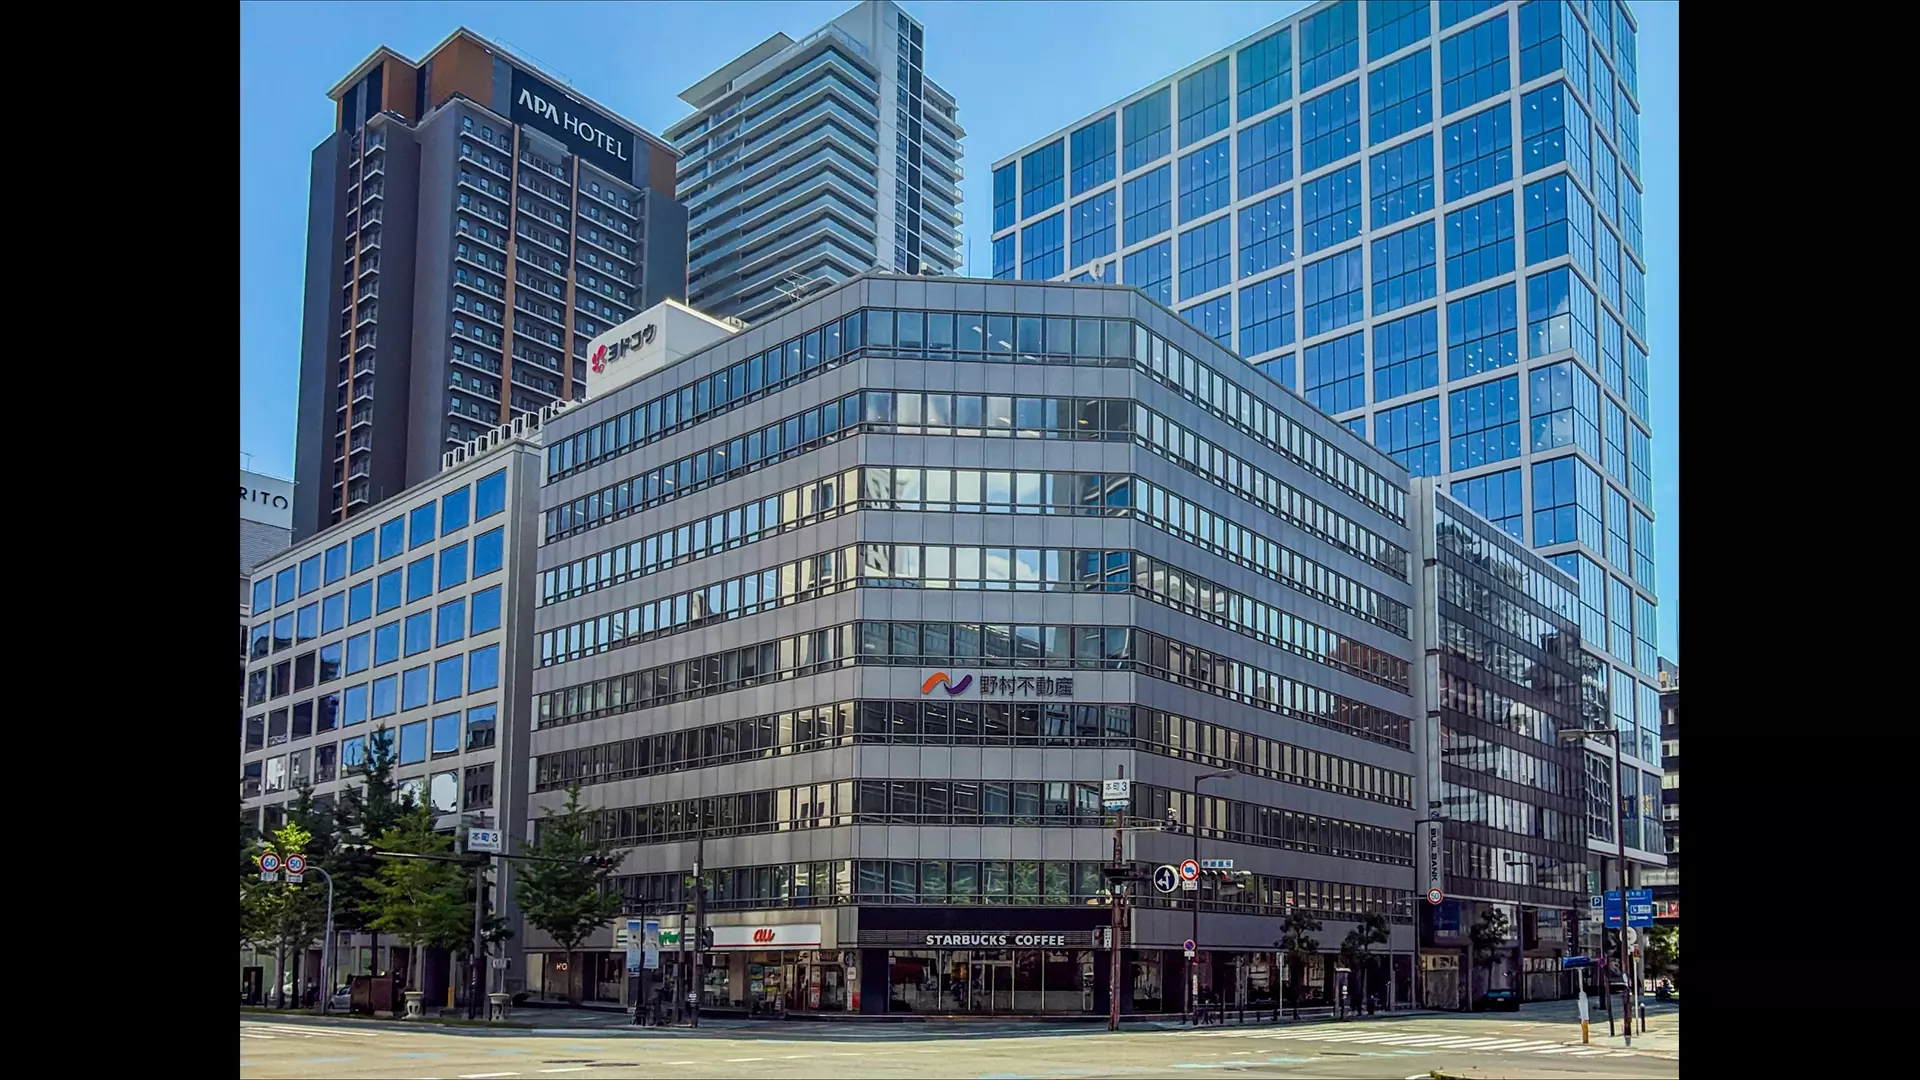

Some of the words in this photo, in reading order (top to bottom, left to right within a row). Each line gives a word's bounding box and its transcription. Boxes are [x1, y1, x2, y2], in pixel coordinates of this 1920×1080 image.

[518, 88, 560, 125] APA
[563, 111, 627, 161] HOTEL
[608, 324, 657, 363] ヨドコウ
[240, 486, 288, 510] RITO
[979, 675, 1074, 697] 野村不動産
[1121, 781, 1127, 791] 3
[491, 833, 498, 842] 3
[264, 858, 276, 867] 60
[290, 859, 301, 869] 50
[1430, 892, 1440, 900] 50
[753, 928, 775, 942] au
[926, 935, 1007, 946] STARBUCKS
[1015, 935, 1065, 946] COFFEE
